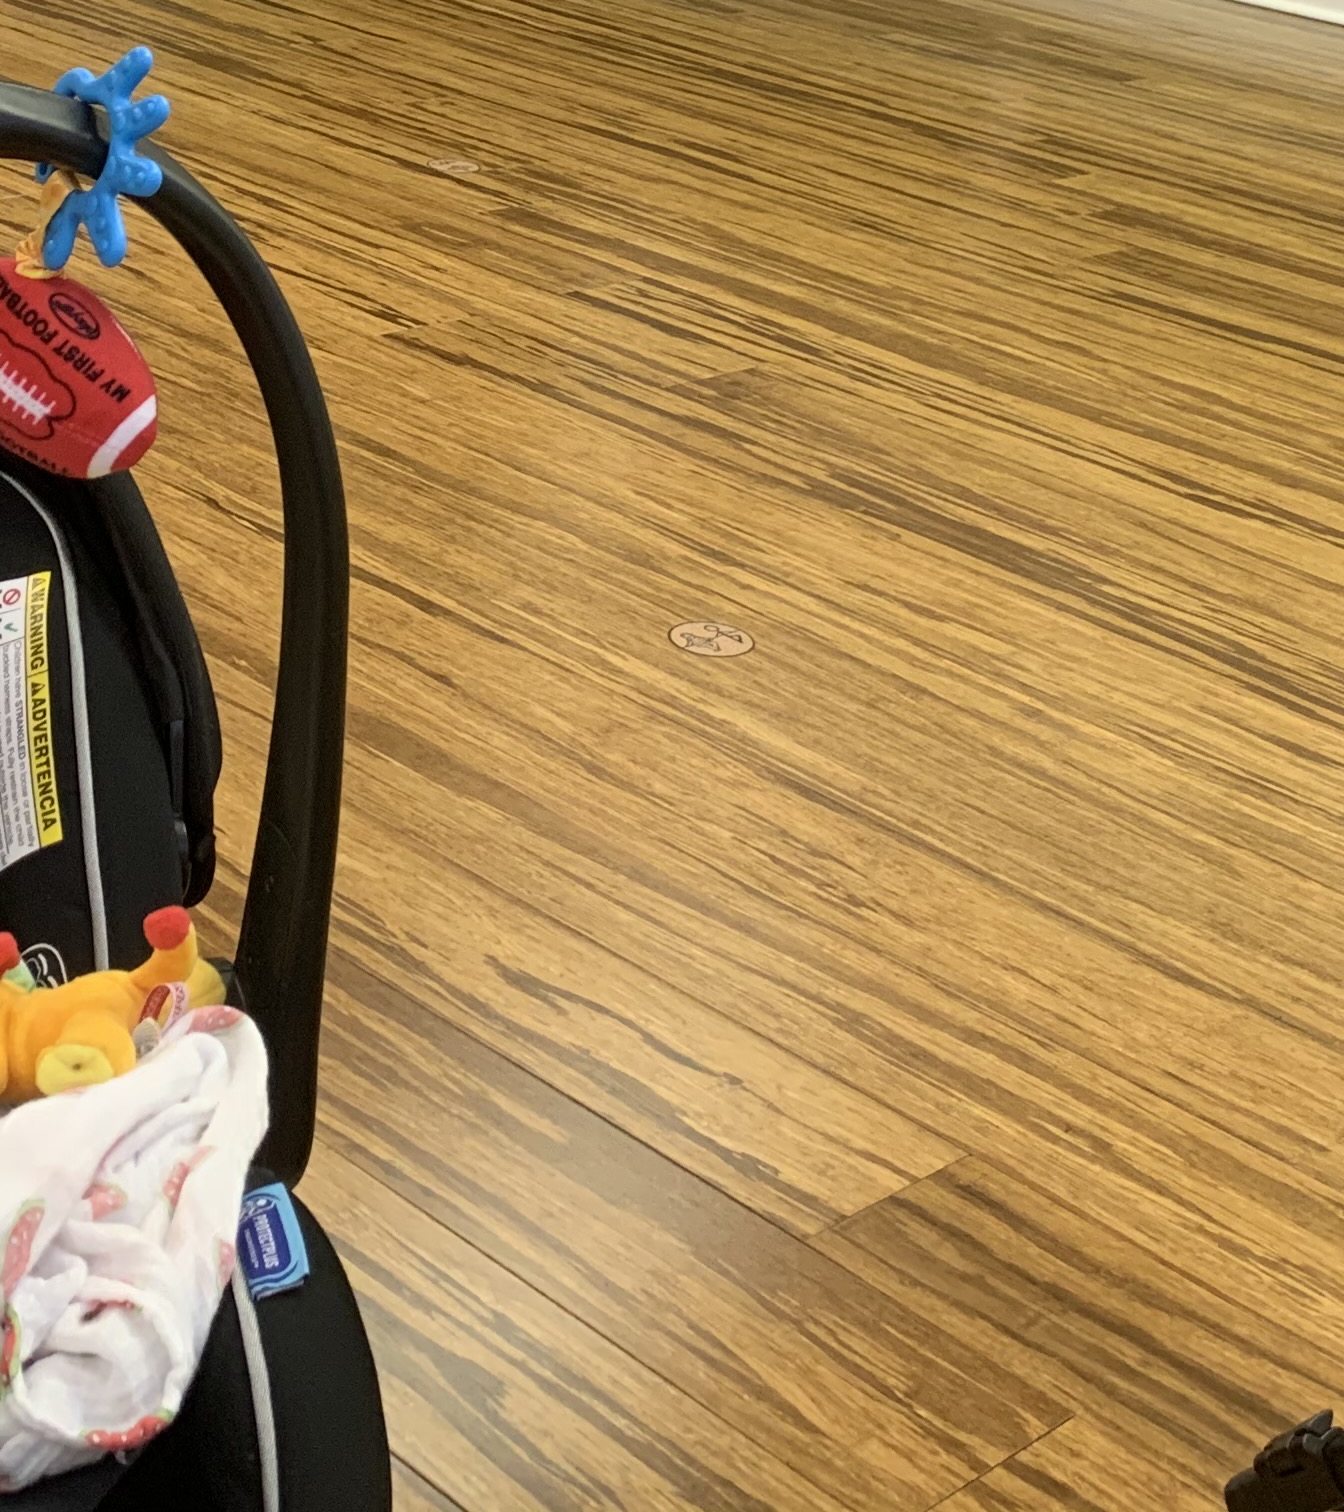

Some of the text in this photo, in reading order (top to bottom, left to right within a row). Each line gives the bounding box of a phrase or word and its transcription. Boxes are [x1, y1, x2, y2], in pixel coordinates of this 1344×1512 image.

[52, 339, 105, 383] FIRST
[100, 378, 131, 403] MY
[30, 587, 45, 670] WARNING
[14, 699, 26, 759] STRANGLED
[30, 698, 57, 832] ADVERTENCIA
